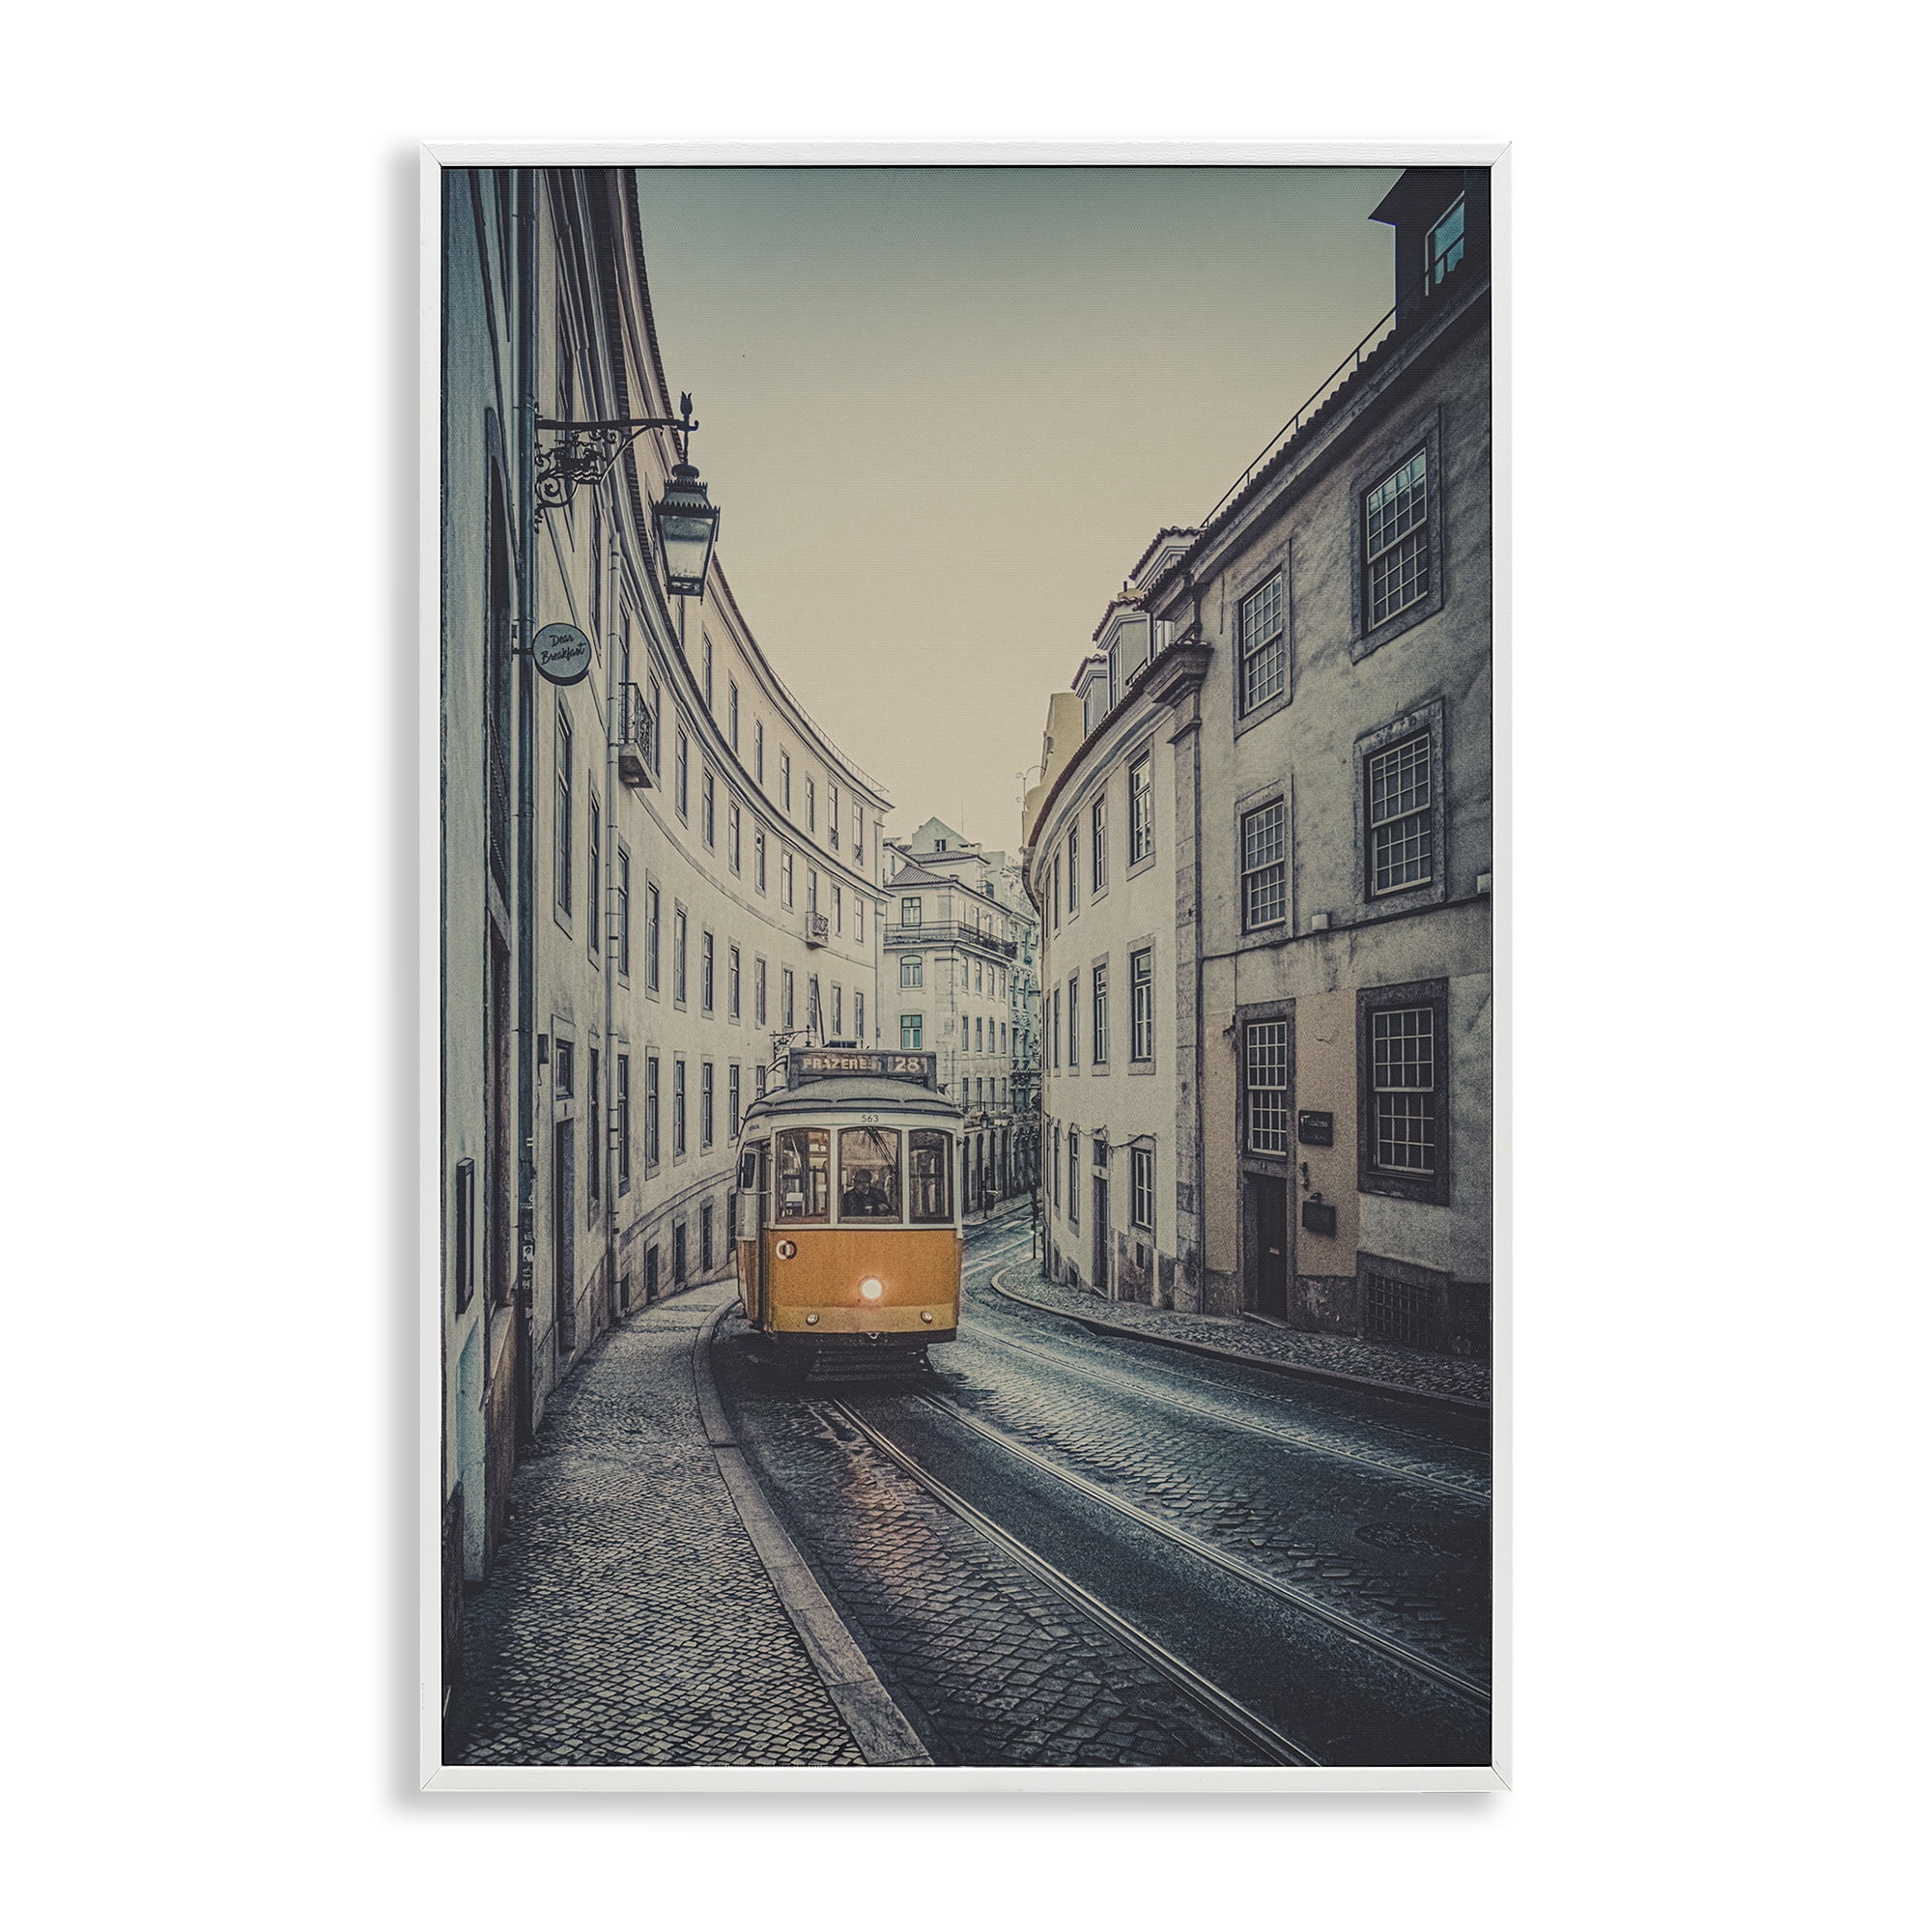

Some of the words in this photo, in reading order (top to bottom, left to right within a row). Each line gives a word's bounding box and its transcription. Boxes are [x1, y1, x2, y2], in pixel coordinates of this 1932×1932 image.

[549, 634, 574, 647] Dear
[540, 642, 586, 666] Breakfast
[895, 1056, 921, 1072] 28
[861, 1114, 879, 1122] 563
